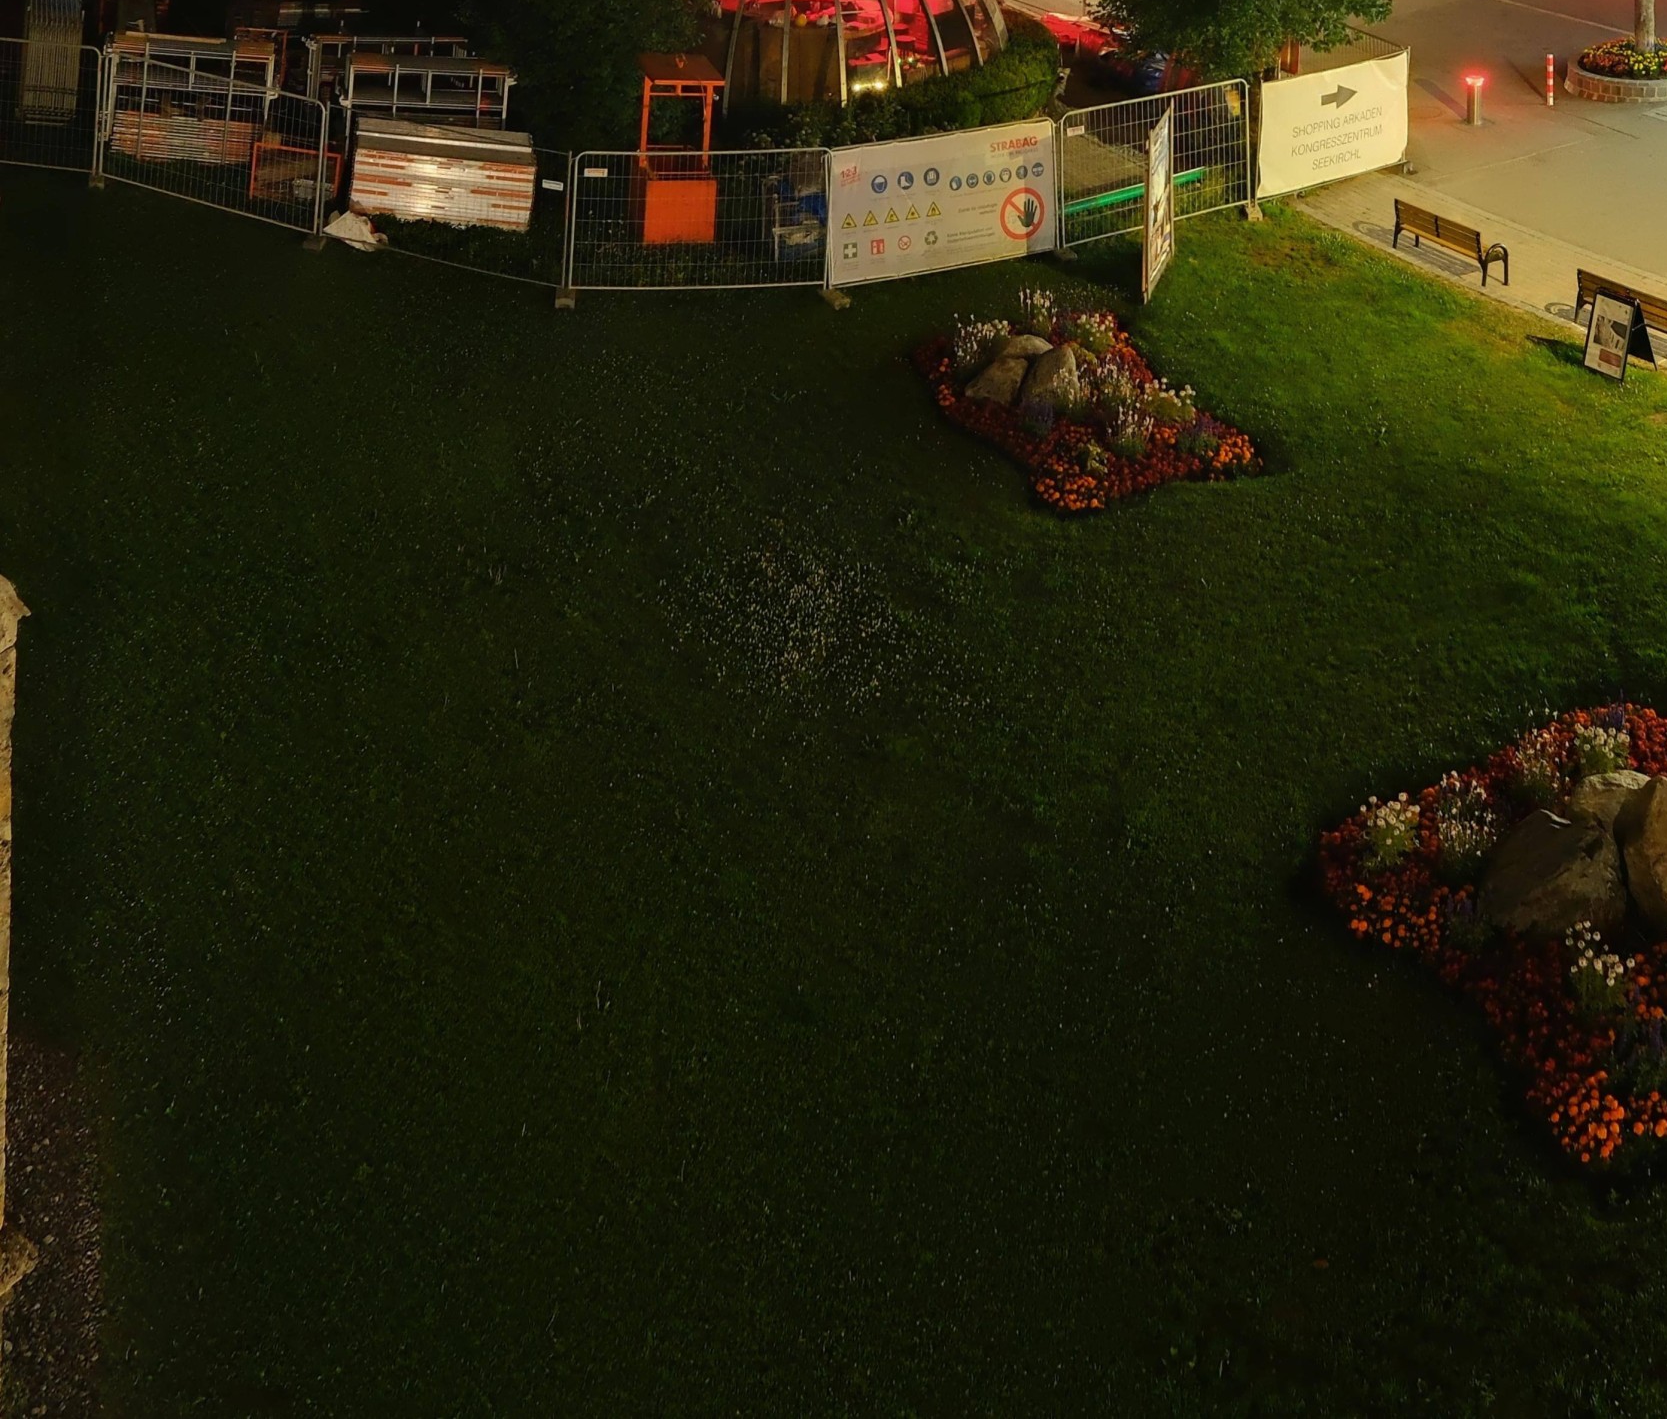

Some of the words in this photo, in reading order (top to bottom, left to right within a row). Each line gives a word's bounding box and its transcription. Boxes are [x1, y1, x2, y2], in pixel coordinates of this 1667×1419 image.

[1292, 116, 1341, 139] SHOPPING
[1342, 106, 1383, 126] ARKADEN
[990, 136, 1038, 152] STRABAG
[1291, 124, 1383, 157] KONGRESSZENTRUM
[1312, 148, 1361, 171] SEEKIRCHL
